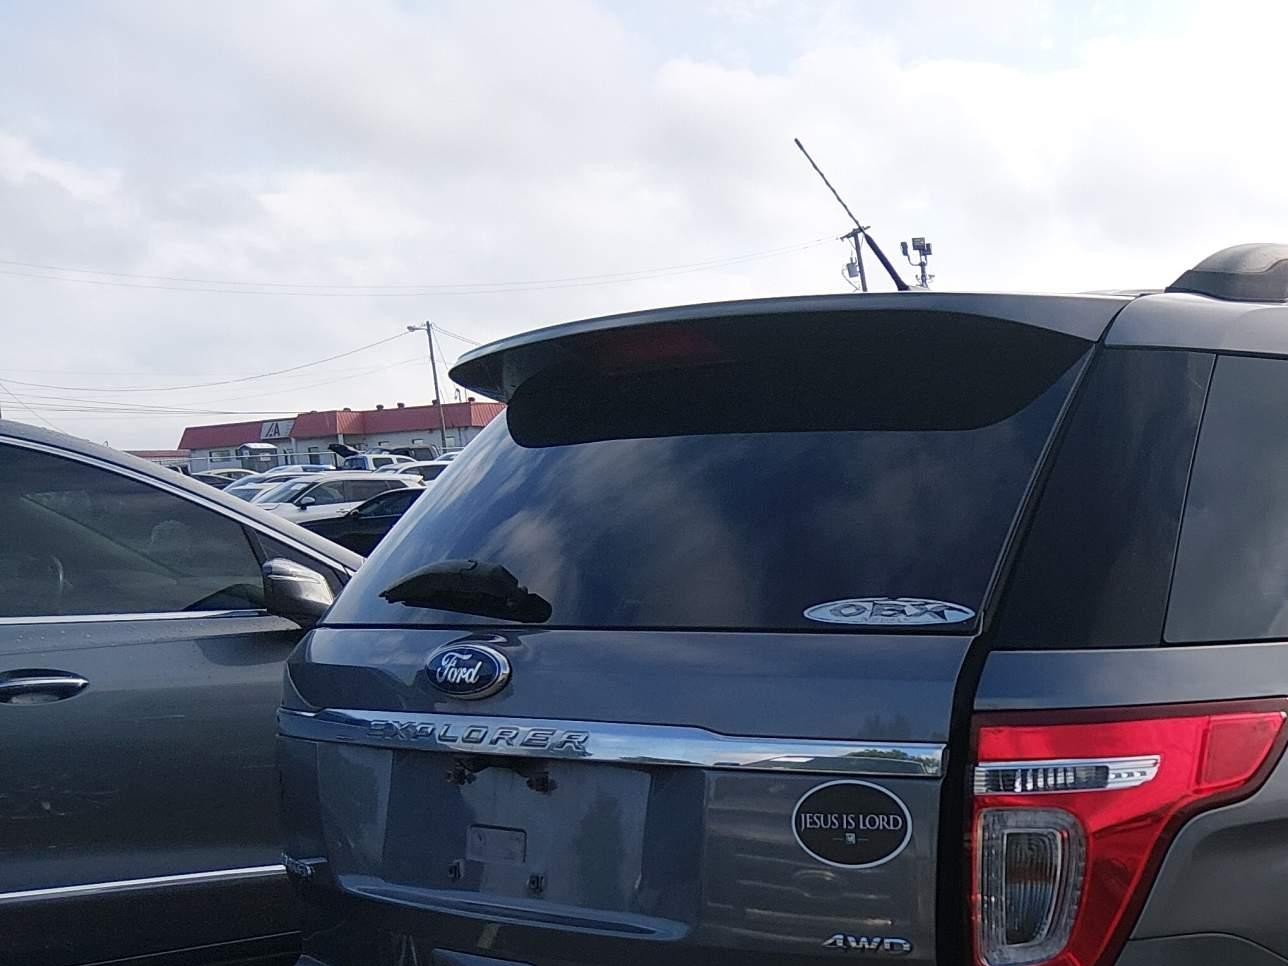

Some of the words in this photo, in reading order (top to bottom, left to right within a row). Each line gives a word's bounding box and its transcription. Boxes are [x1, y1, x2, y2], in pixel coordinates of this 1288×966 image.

[436, 652, 481, 684] Ford
[366, 719, 591, 752] EXPLORER
[800, 813, 839, 832] JESUS
[842, 814, 856, 829] IS
[859, 814, 903, 830] LORD
[821, 934, 913, 954] 4WD
